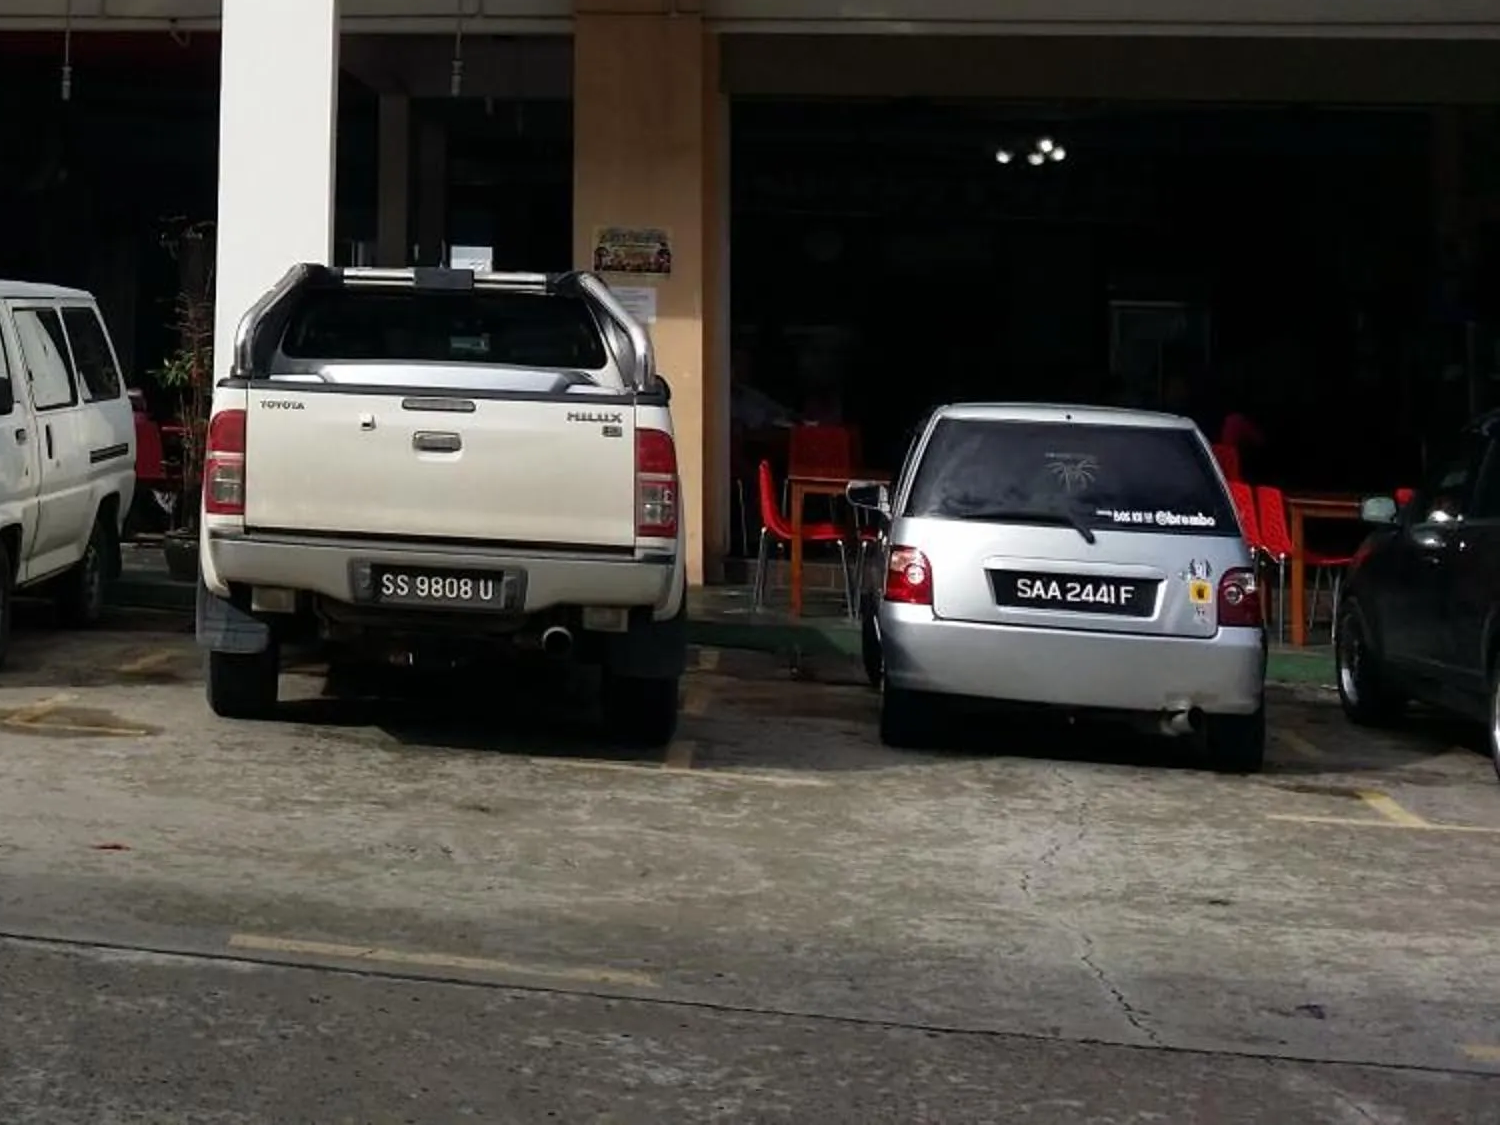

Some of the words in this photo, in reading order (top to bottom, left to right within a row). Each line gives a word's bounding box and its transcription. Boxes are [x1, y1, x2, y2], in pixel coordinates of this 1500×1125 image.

[381, 573, 409, 597] SS
[416, 576, 473, 600] 9808
[479, 579, 494, 601] U
[1016, 578, 1063, 600] SAA
[1066, 581, 1116, 605] 2441
[1119, 585, 1136, 605] F
